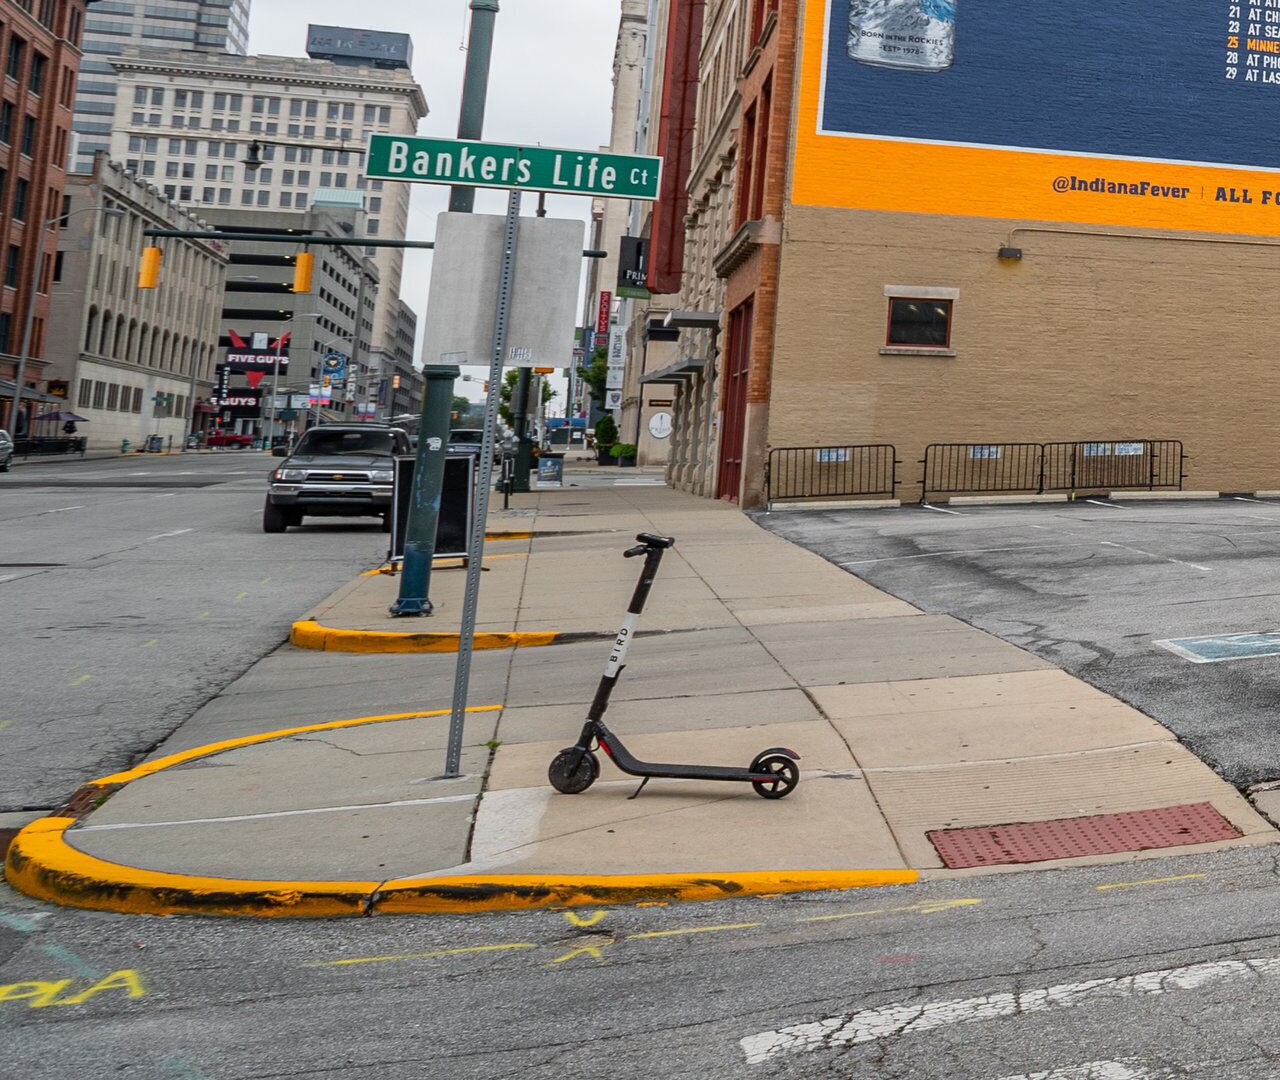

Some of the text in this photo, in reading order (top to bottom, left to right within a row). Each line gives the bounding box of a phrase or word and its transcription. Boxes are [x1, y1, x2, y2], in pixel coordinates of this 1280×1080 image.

[1228, 5, 1241, 19] 21
[1247, 7, 1263, 21] AT
[1227, 20, 1241, 34] 23
[1247, 23, 1262, 36] AT
[860, 30, 944, 47] BORN ROCKIES
[1227, 35, 1239, 49] 25
[1225, 51, 1239, 65] 28
[1245, 53, 1261, 67] AT
[1225, 66, 1238, 80] 29
[1245, 68, 1260, 82] AT
[387, 140, 649, 190] Bankers Life Ct
[1052, 176, 1190, 199] @IndianaFever
[1215, 187, 1253, 204] ALL
[227, 354, 289, 364] FIVE GUYS
[345, 364, 358, 401] PARK
[608, 628, 628, 663] BIRD
